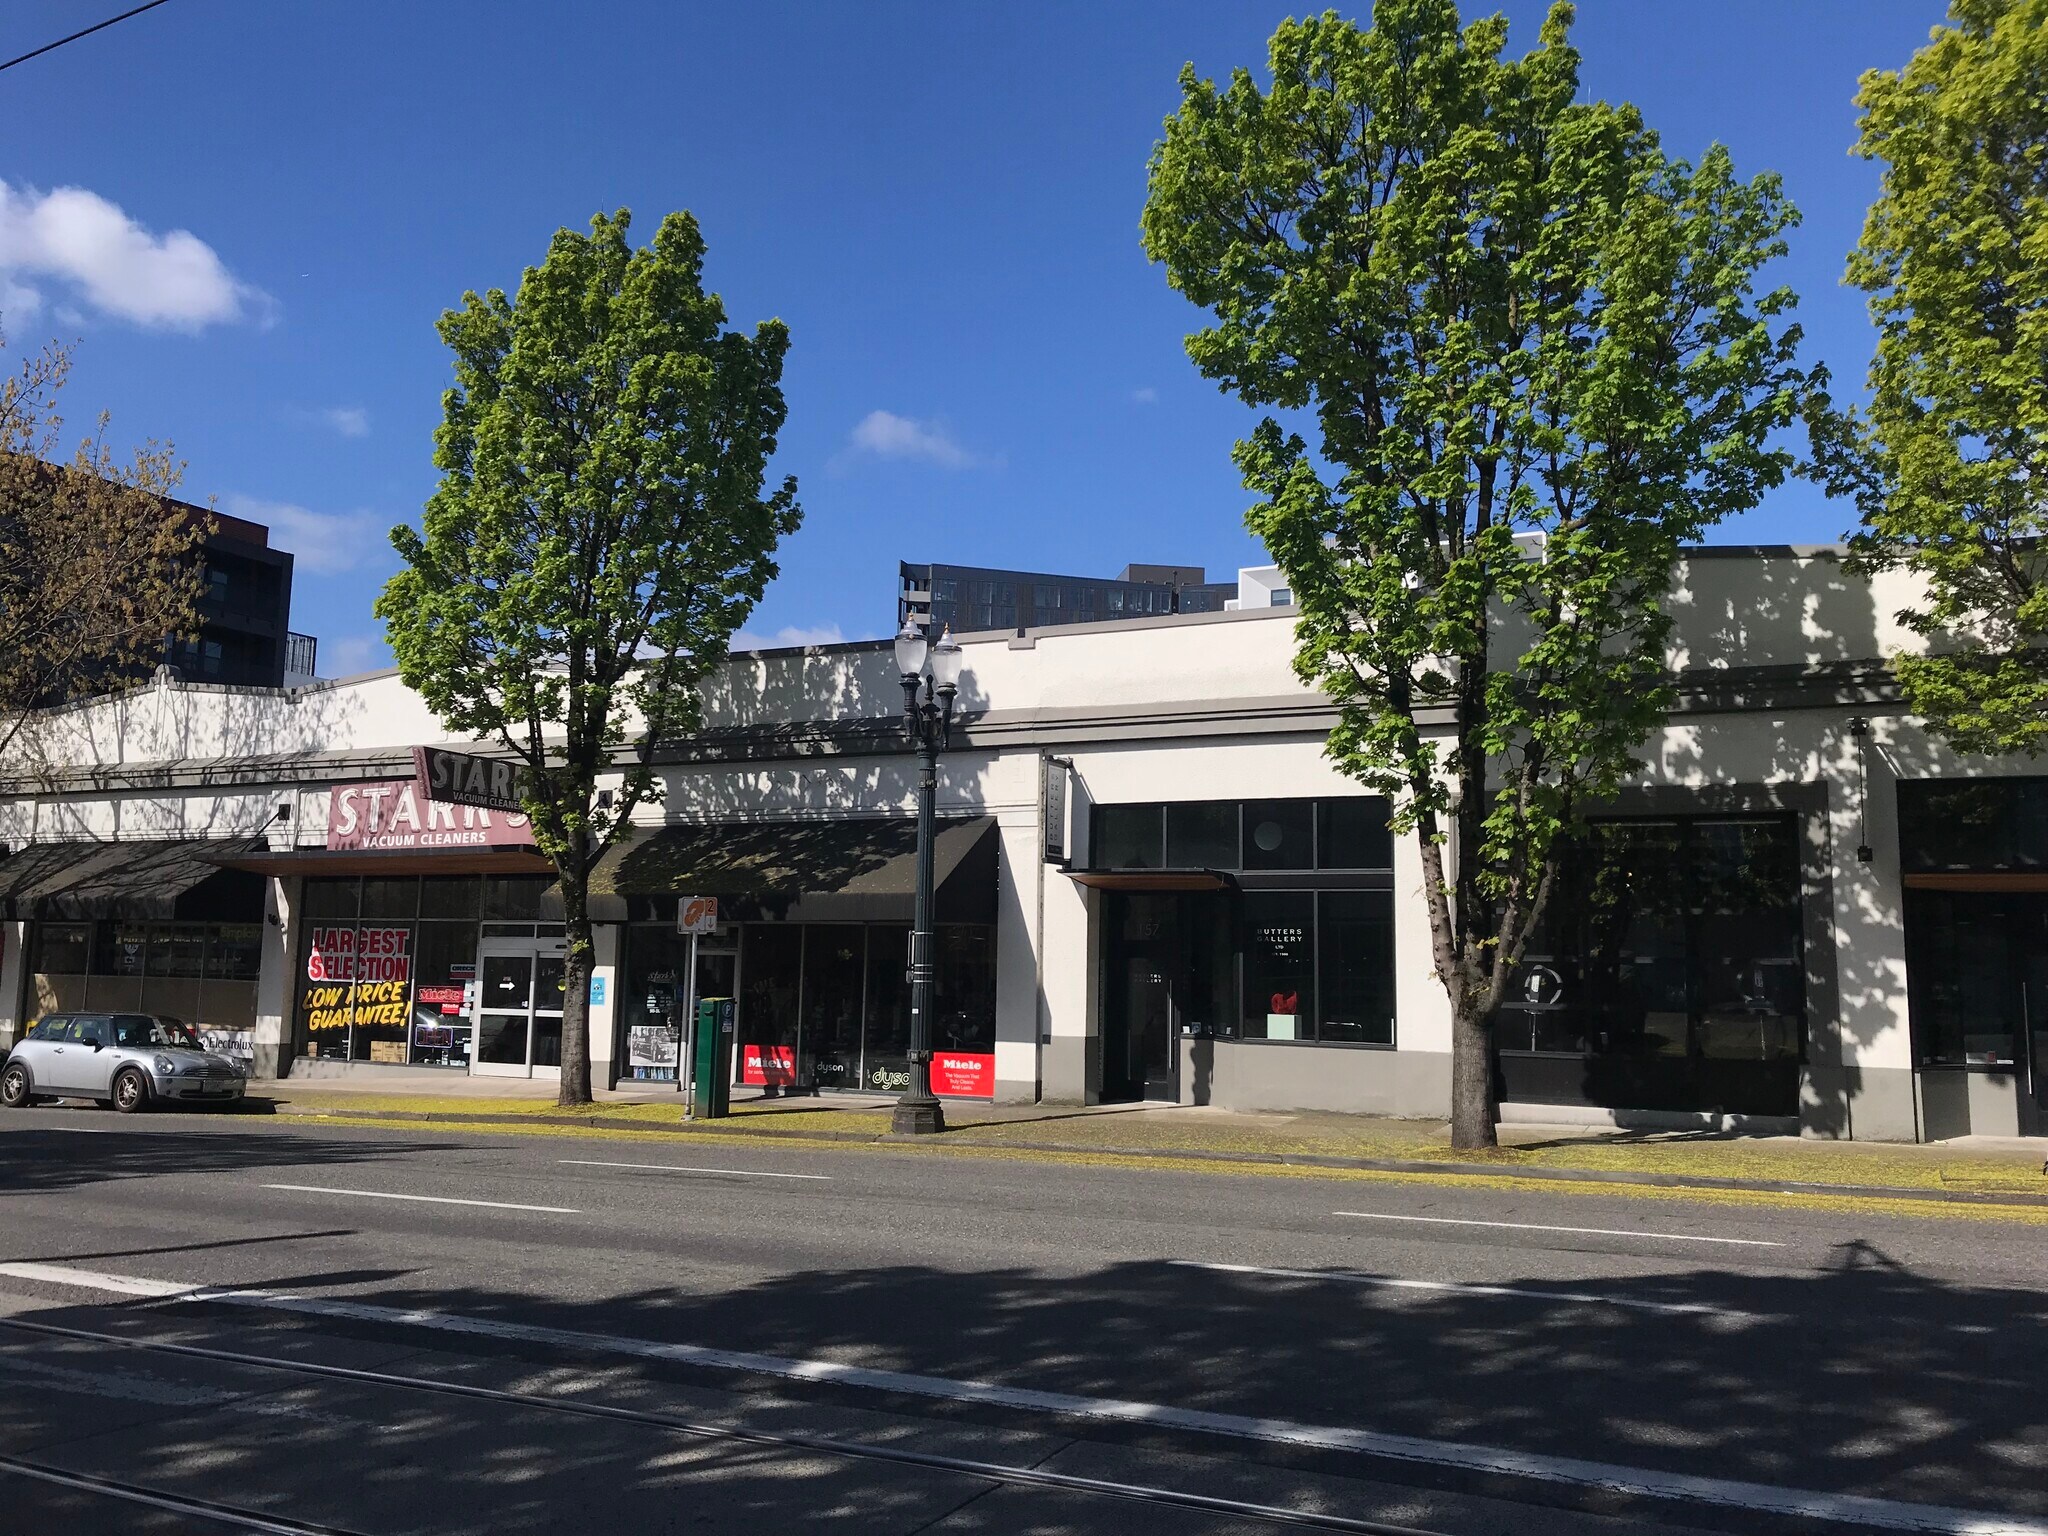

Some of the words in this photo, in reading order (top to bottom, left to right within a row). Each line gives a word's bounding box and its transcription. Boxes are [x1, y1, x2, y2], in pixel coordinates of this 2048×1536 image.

[453, 791, 488, 804] VACUUM
[489, 798, 524, 810] CLEANER
[363, 834, 415, 848] VACUUM
[420, 831, 486, 846] CLEANERS
[707, 899, 714, 913] 2
[313, 927, 410, 955] LARGEST
[308, 955, 410, 983] SELECTION
[303, 986, 343, 1010] LOW
[347, 981, 406, 1005] PRICE
[418, 987, 460, 1000] Miele
[308, 1001, 412, 1031] GUARANTEE!
[209, 1036, 254, 1051] Electrolux
[747, 1056, 791, 1069] Miele
[816, 1061, 844, 1073] dyson
[943, 1059, 982, 1070] Miele
[872, 1066, 911, 1090] dyso
